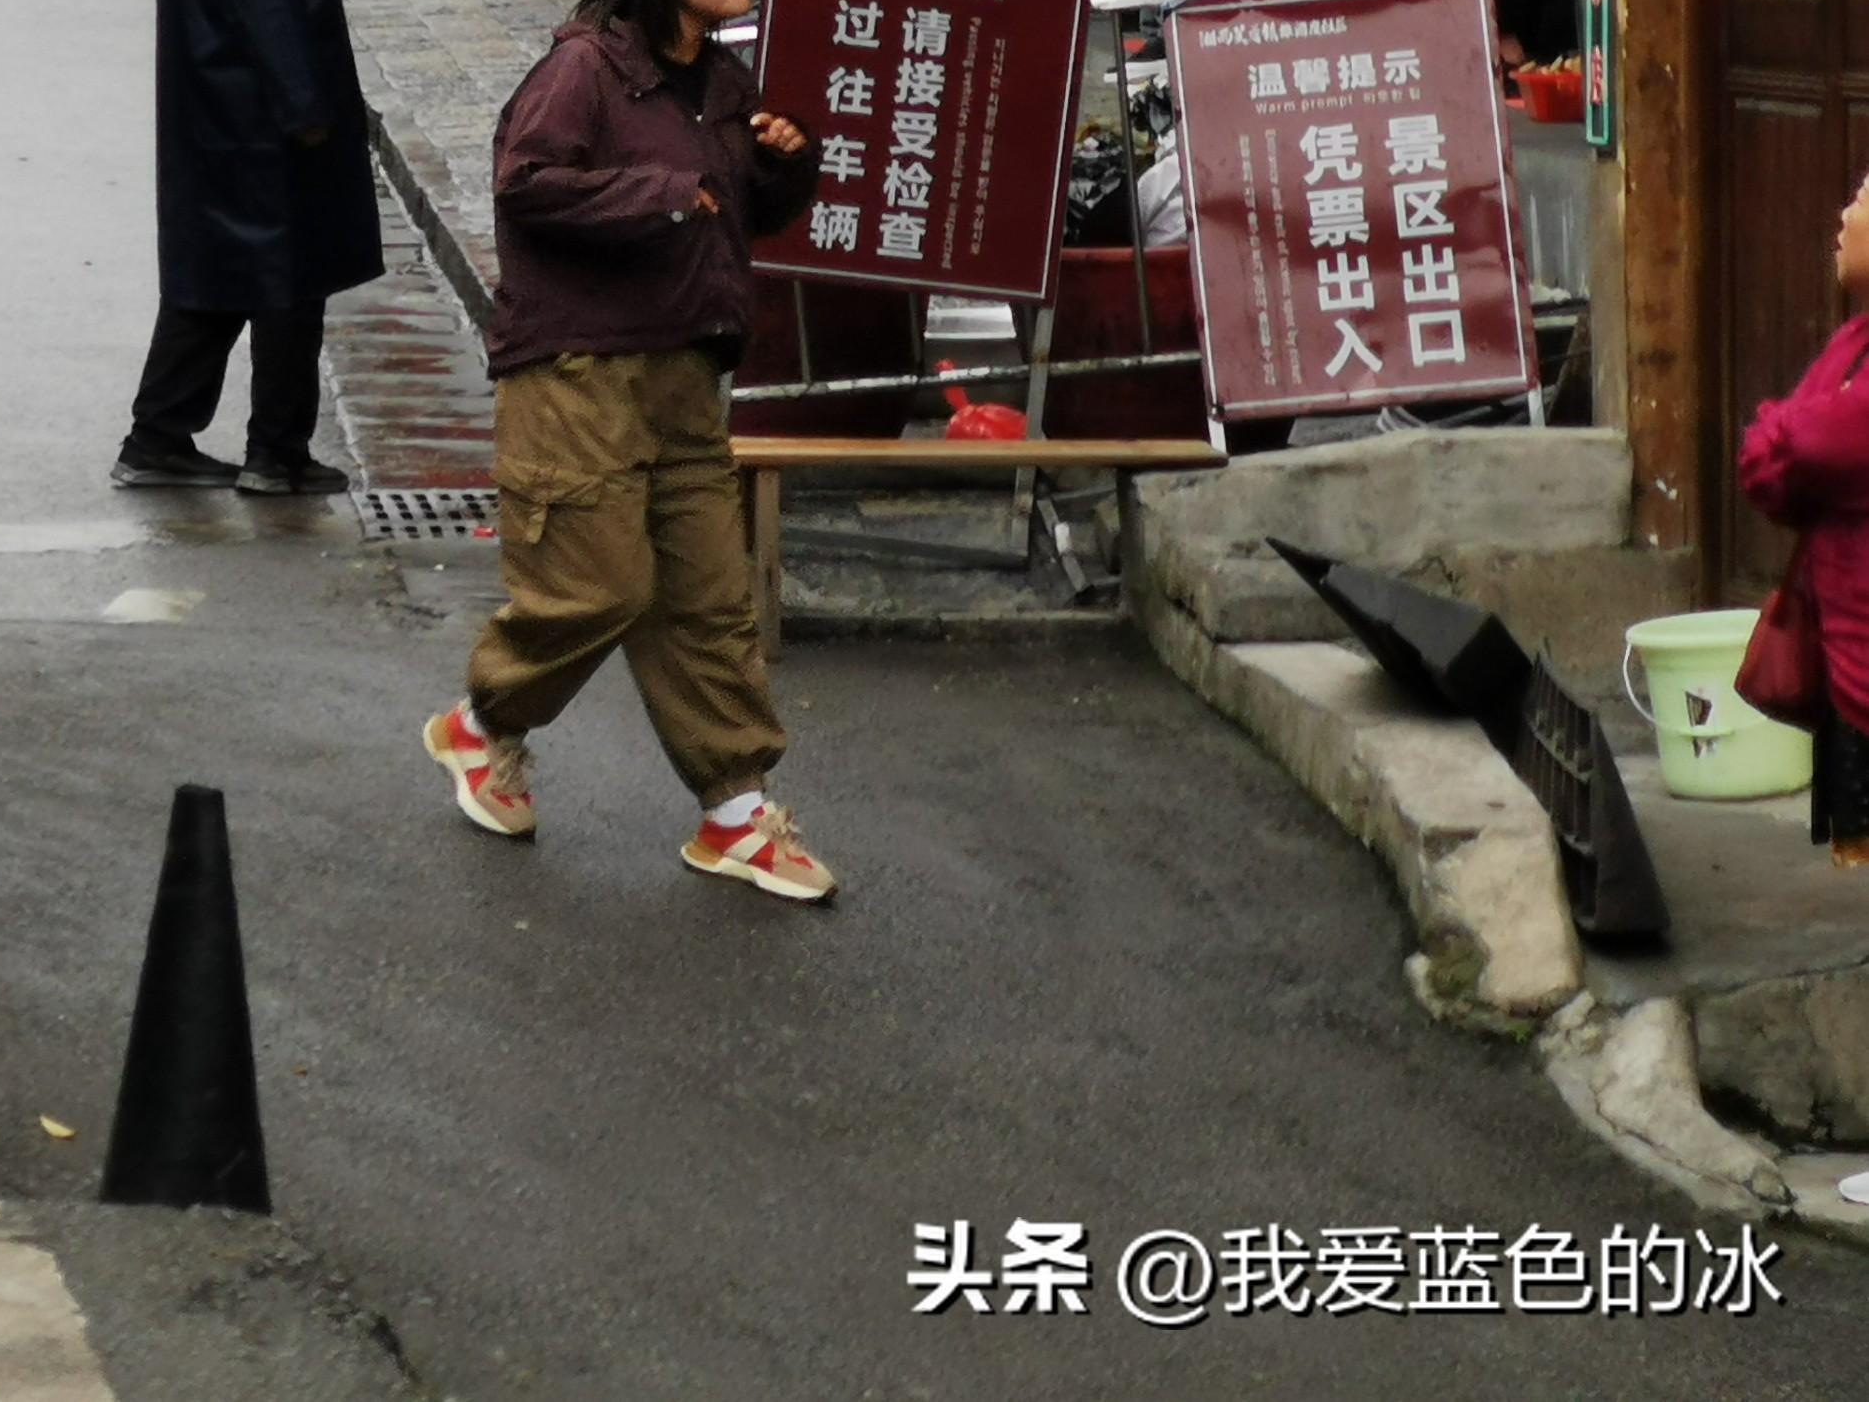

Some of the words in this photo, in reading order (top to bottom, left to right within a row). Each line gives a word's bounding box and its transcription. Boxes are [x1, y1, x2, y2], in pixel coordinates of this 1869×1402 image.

[809, 0, 884, 252] 过往车辆
[876, 7, 951, 259] 请接受检查
[1248, 49, 1421, 100] 温馨提示
[1255, 100, 1296, 115] Warm
[1301, 93, 1353, 112] prompt
[1300, 122, 1383, 377] 凭票出入
[1385, 114, 1465, 367] 景区出口
